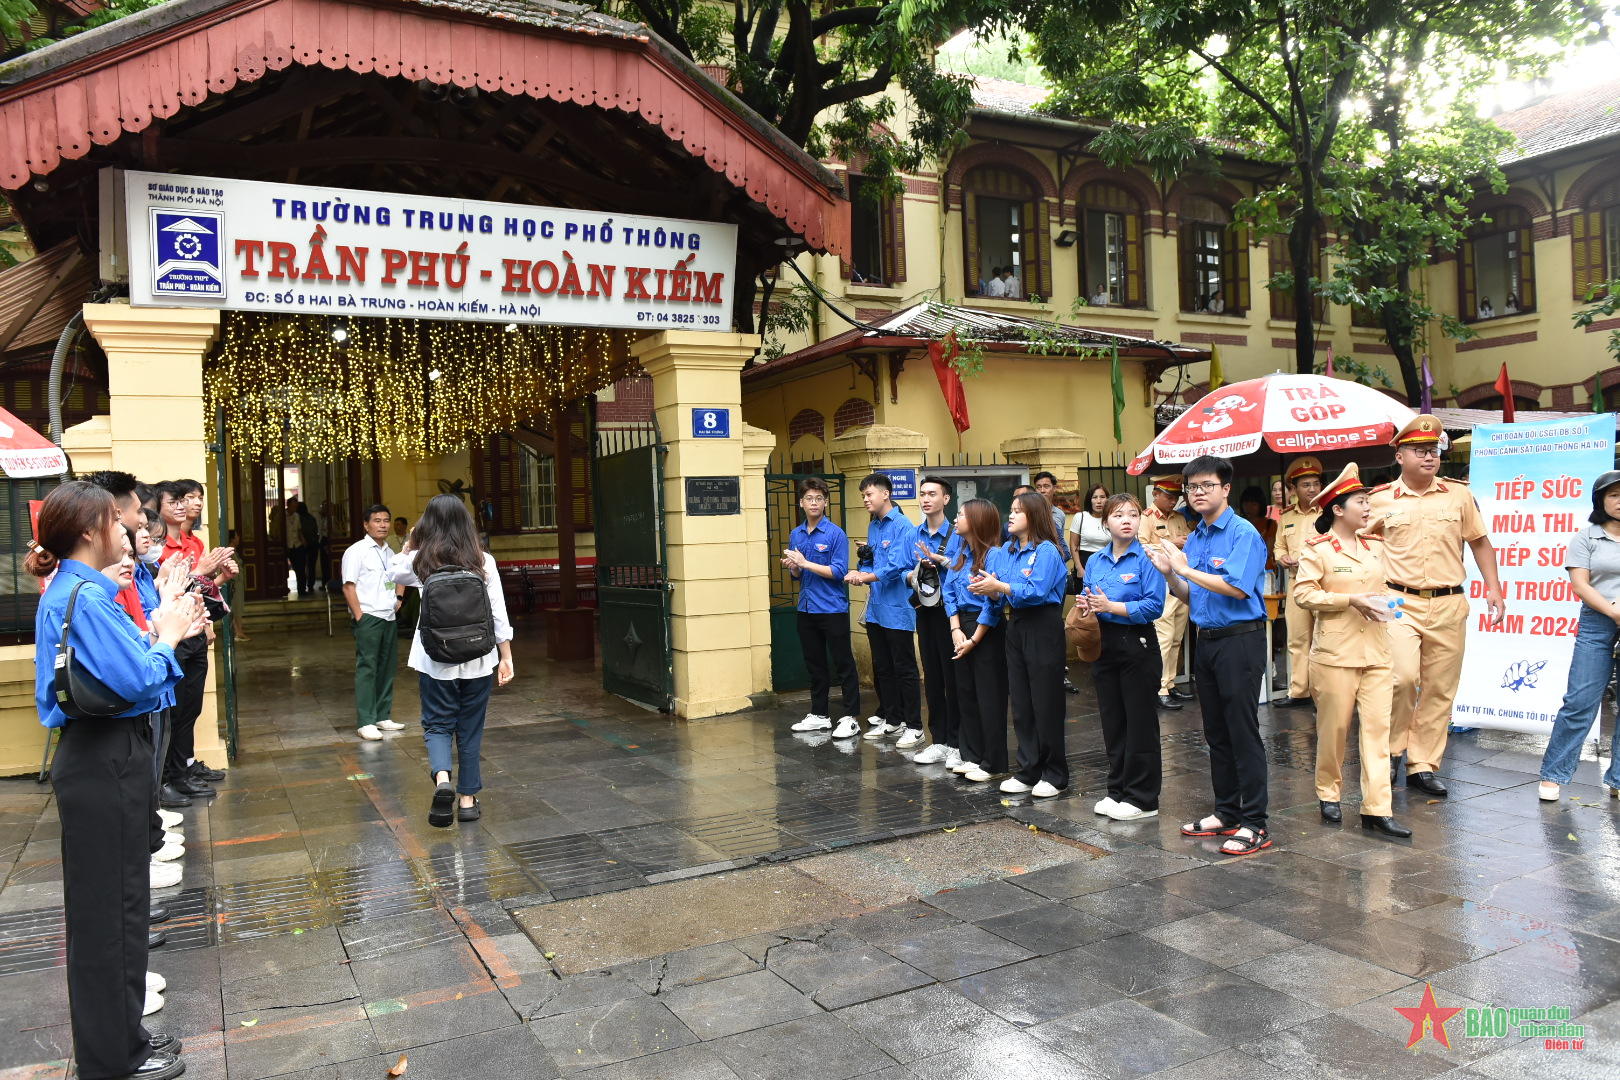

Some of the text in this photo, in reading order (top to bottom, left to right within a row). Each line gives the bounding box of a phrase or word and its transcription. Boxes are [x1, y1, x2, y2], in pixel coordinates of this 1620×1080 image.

[148, 193, 174, 202] THÀNH
[209, 198, 223, 207] NỘI
[272, 197, 700, 250] TRƯỜNG TRUNG HỌC PHỔ THÔNG
[235, 224, 369, 282] TRẦN
[381, 241, 470, 288] PHÚ
[501, 250, 616, 297] HOÀN
[624, 253, 724, 303] KIẾM
[245, 292, 269, 302] ĐC:
[274, 289, 294, 304] SỐ
[298, 295, 305, 304] 8
[309, 295, 332, 306] HAI
[338, 294, 356, 307] BÀ
[361, 297, 406, 309] TRƯNG
[418, 299, 454, 311] HOÀN
[458, 299, 488, 313] KIẾM
[500, 303, 516, 314] HÀ
[520, 304, 540, 317] NỘI
[637, 312, 654, 322] ĐT:
[657, 313, 668, 322] 04
[672, 314, 694, 323] 3825
[704, 413, 716, 428] 8
[1291, 402, 1346, 422] GÓP
[1210, 439, 1256, 455] S-STUDENT
[1536, 444, 1551, 452] GIAO
[1594, 440, 1607, 449] NỘI
[1495, 475, 1582, 500] TIẾP SỨC
[1492, 511, 1579, 533] MÙA THI.
[1538, 543, 1568, 566] SỨ
[1530, 616, 1580, 637] 2024
